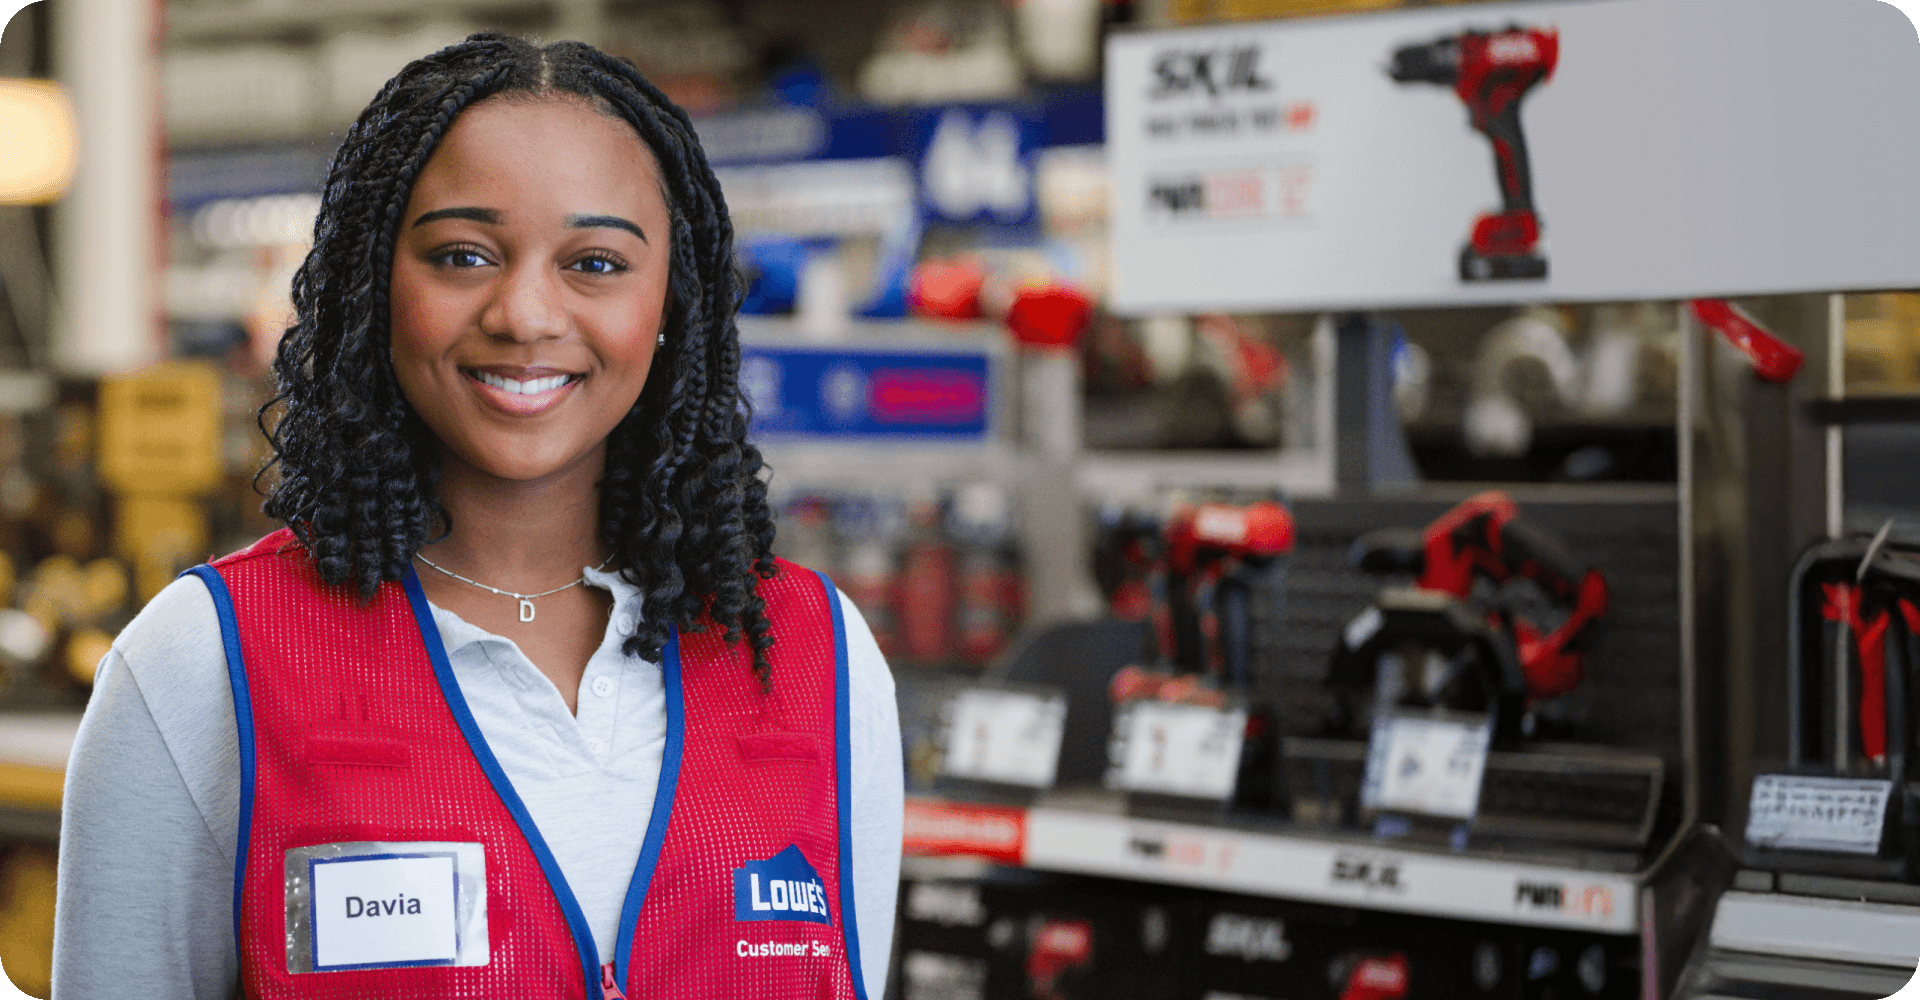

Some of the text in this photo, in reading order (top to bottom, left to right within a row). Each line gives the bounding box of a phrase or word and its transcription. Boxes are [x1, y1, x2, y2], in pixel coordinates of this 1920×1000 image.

[1149, 45, 1273, 98] SKIL
[519, 600, 535, 622] D
[345, 893, 421, 918] Davia
[750, 873, 827, 916] LOWE'S
[736, 940, 809, 957] Customer
